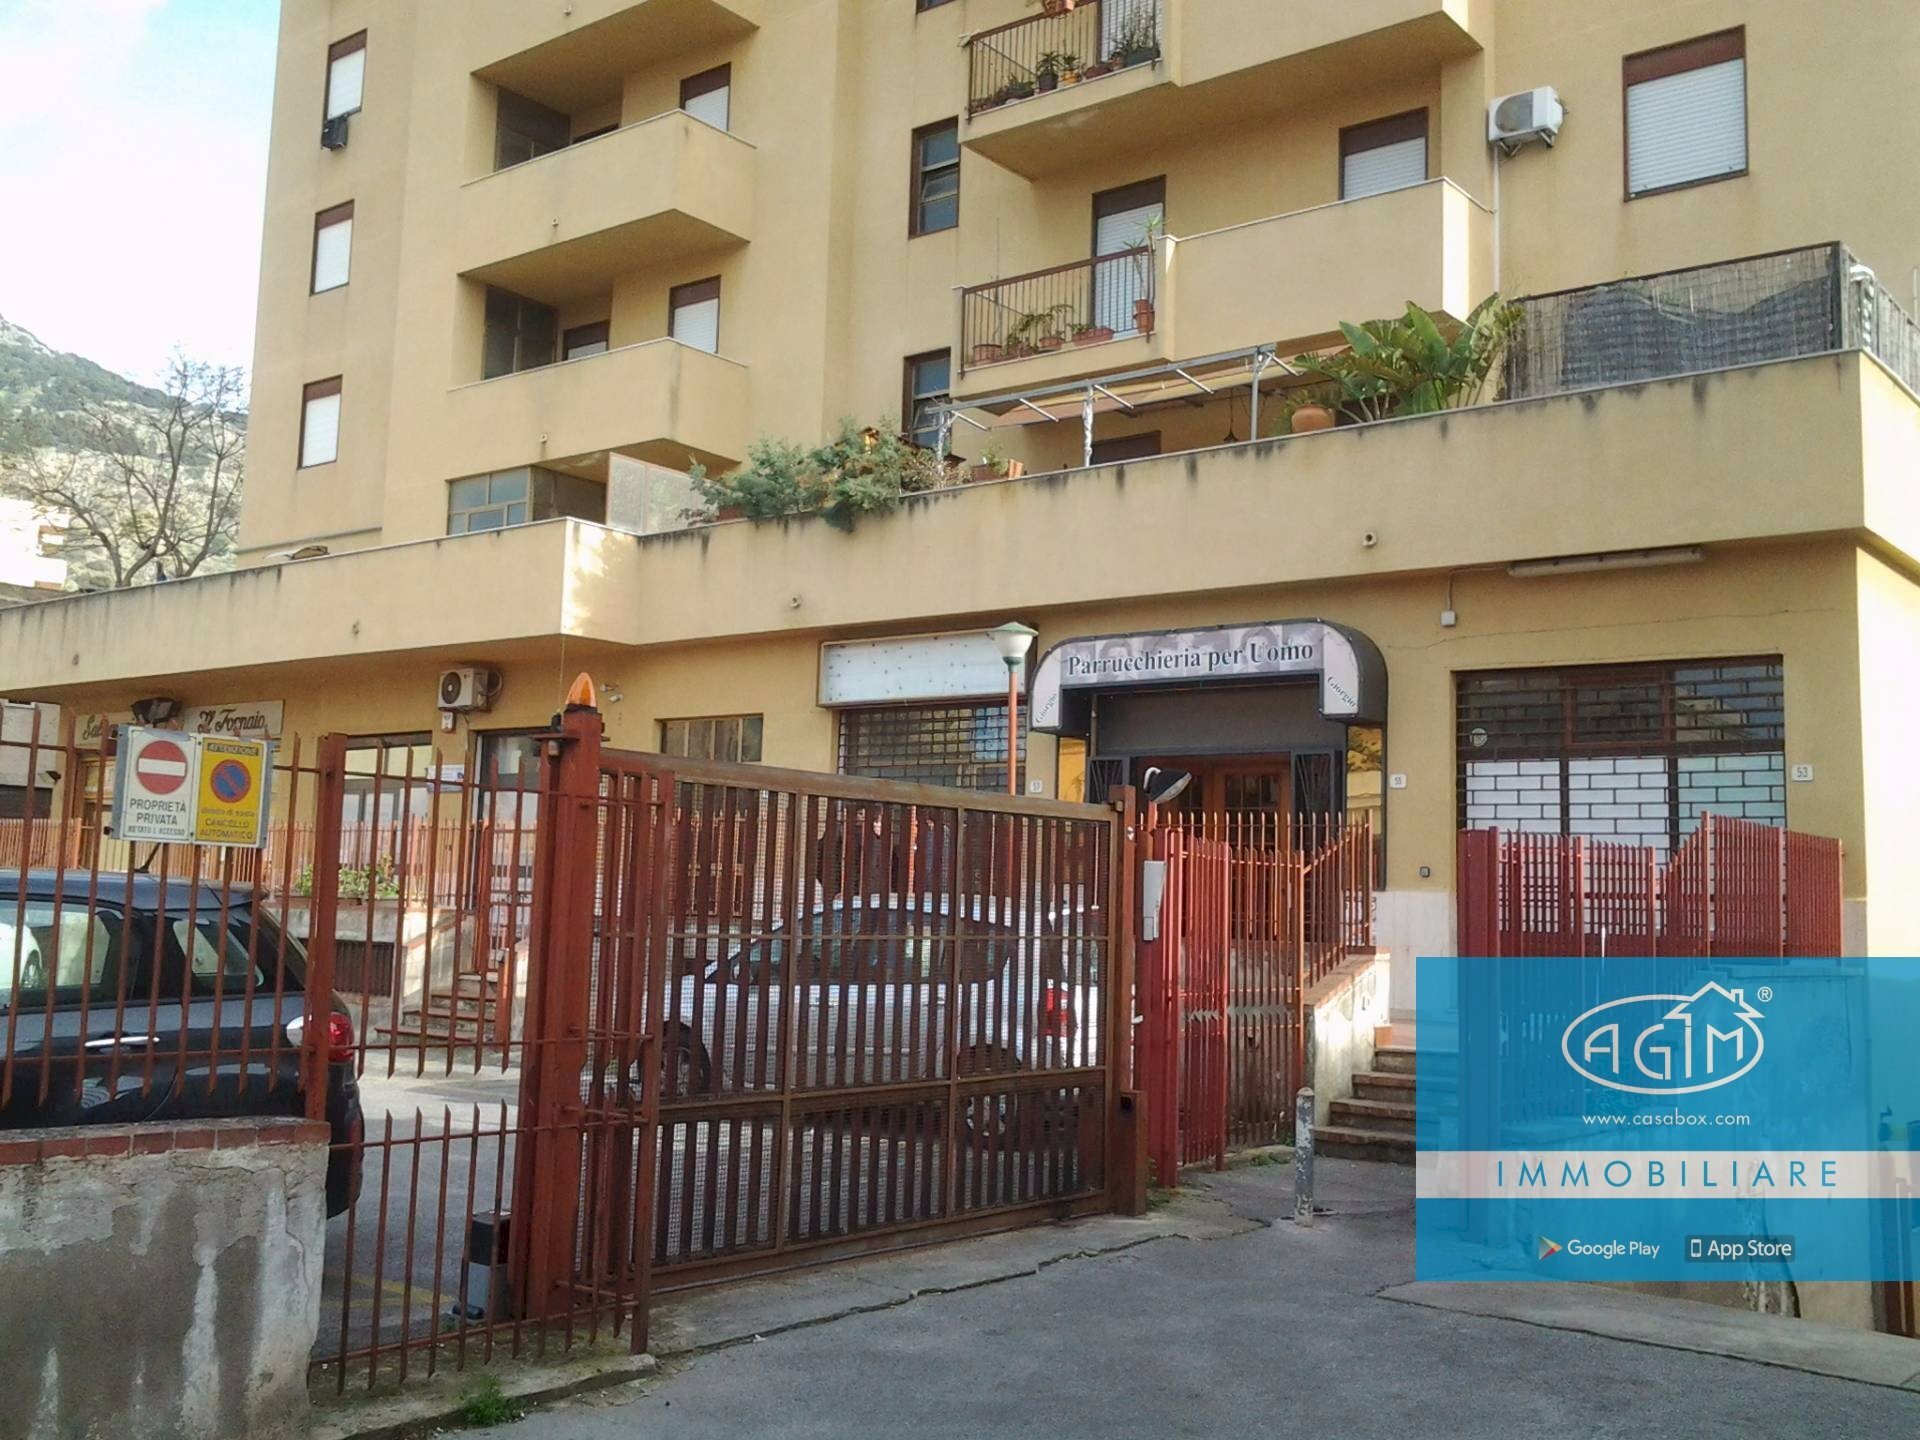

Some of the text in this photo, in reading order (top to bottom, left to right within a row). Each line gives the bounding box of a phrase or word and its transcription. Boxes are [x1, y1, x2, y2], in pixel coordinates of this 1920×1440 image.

[1068, 642, 1314, 676] Parrucchieria per Uomo
[129, 798, 187, 813] PROPRIETÀ
[136, 812, 178, 825] PRIVATA
